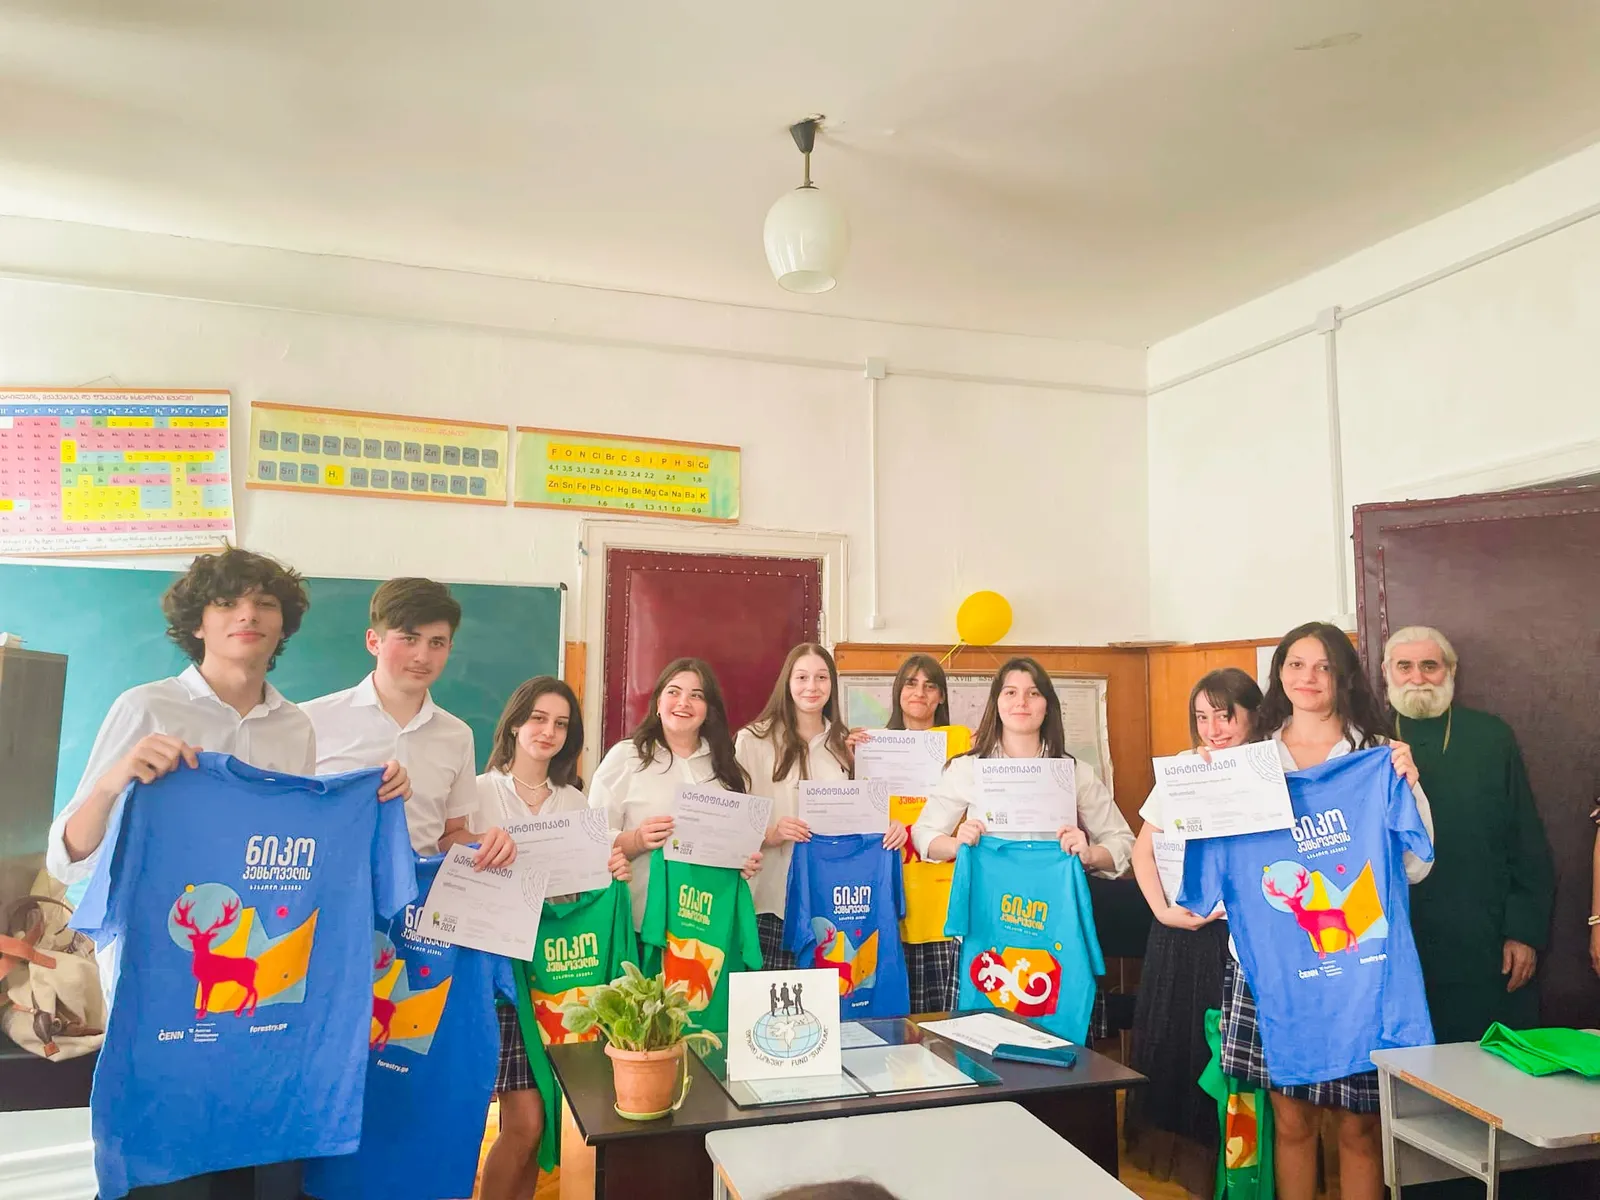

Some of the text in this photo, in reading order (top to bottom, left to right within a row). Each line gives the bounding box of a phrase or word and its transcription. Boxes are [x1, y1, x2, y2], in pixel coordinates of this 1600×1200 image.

[424, 448, 437, 457] Zn
[551, 448, 557, 456] F
[565, 449, 572, 457] O
[605, 453, 615, 461] Br
[621, 454, 627, 462] C
[634, 455, 641, 463] S
[687, 460, 695, 468] Si
[698, 461, 709, 469] Cu
[548, 480, 559, 488] Zn
[562, 481, 573, 489] Sn
[576, 482, 587, 490] Fe
[617, 486, 629, 495] Hg
[644, 488, 656, 497] Mg
[658, 489, 669, 497] Ca
[671, 490, 682, 498] Na
[684, 491, 695, 499] Ba
[870, 735, 916, 745] რტიფიკატი
[982, 765, 1042, 774] სერტიფიკატი
[1165, 759, 1237, 776] სერტიფიკატი
[682, 791, 740, 809] სერტიფიკატი
[806, 787, 860, 796] სერტიფიკატი
[1186, 824, 1203, 833] 2024
[1291, 808, 1348, 842] ნიკო
[245, 835, 316, 867] ნიკო
[242, 865, 312, 881] კეცხოველის
[453, 854, 513, 879] სერტიკატი
[679, 884, 713, 916] ნიკო
[833, 886, 872, 905] ნიკო
[1001, 893, 1048, 922] ნიკო
[440, 922, 456, 933] 2024
[544, 932, 598, 962] ნიკო
[250, 1022, 288, 1033] forestry.ge
[791, 1056, 809, 1067] FUND
